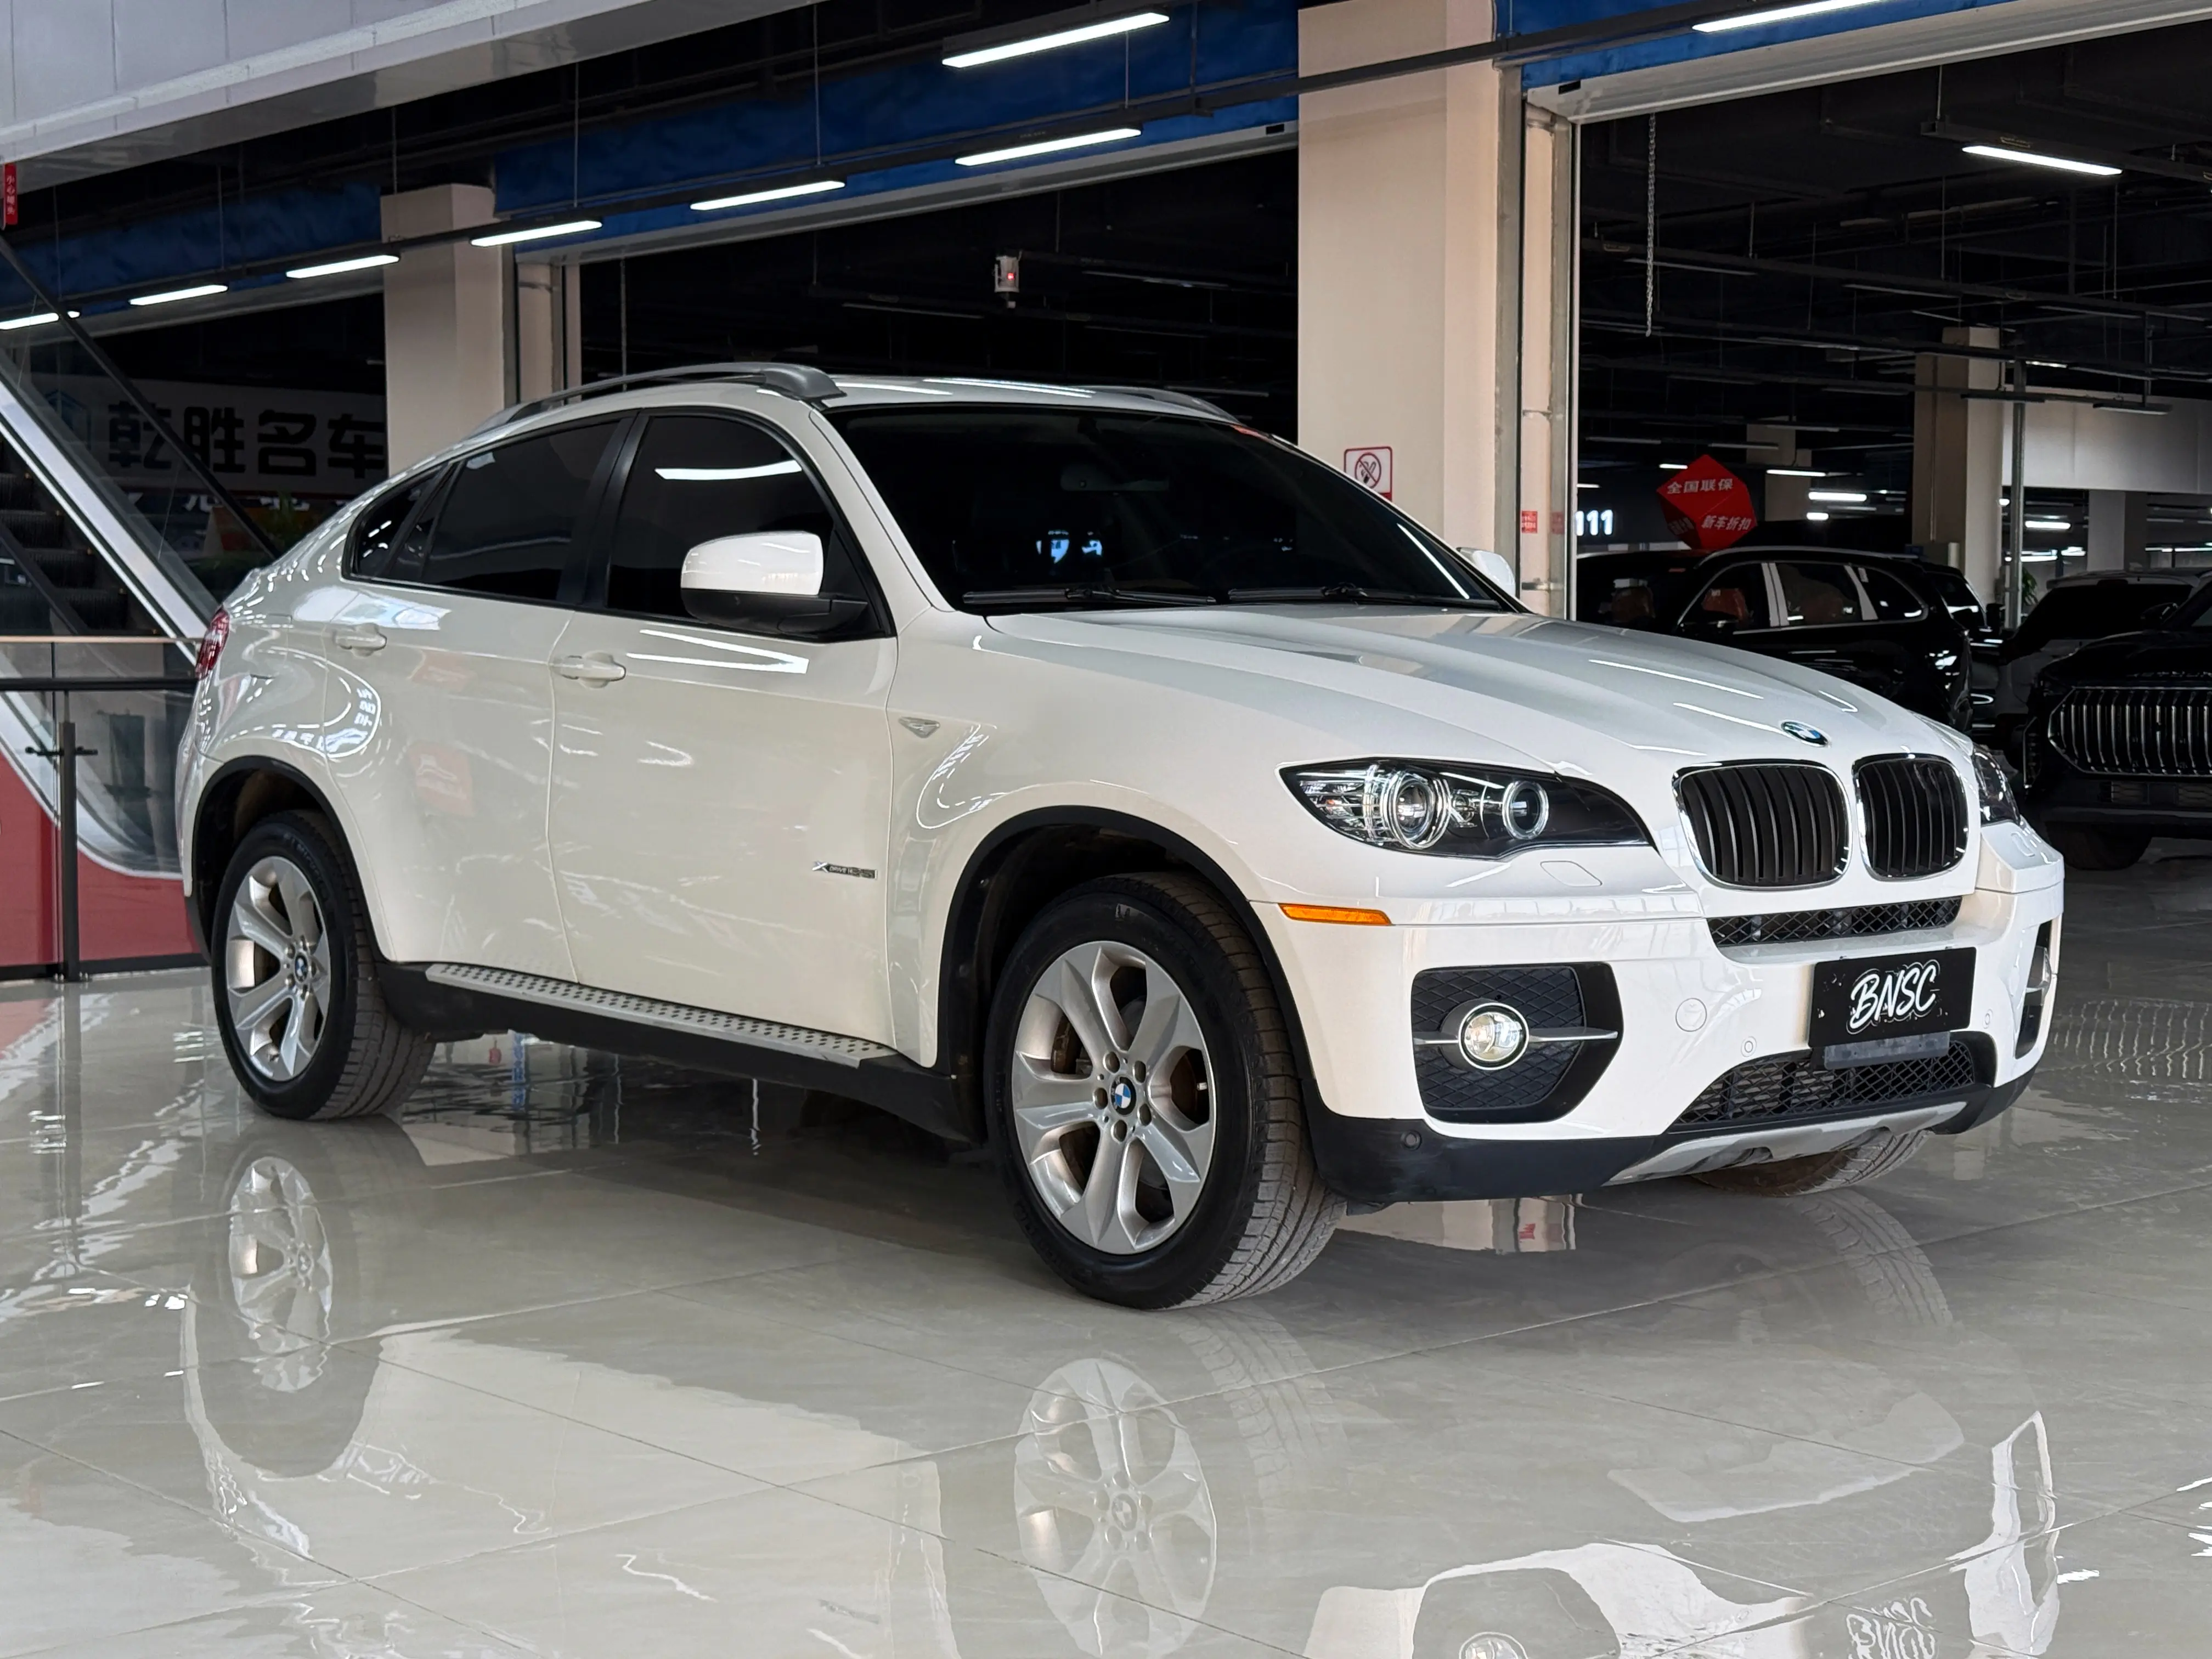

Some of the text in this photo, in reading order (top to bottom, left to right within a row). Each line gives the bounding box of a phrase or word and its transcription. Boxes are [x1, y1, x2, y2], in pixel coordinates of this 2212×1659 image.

[109, 400, 385, 478] 乾胜名车
[1667, 478, 1733, 494] 全国联保
[1701, 515, 1752, 531] 新车折扣
[1849, 965, 1936, 1029] BNSC
